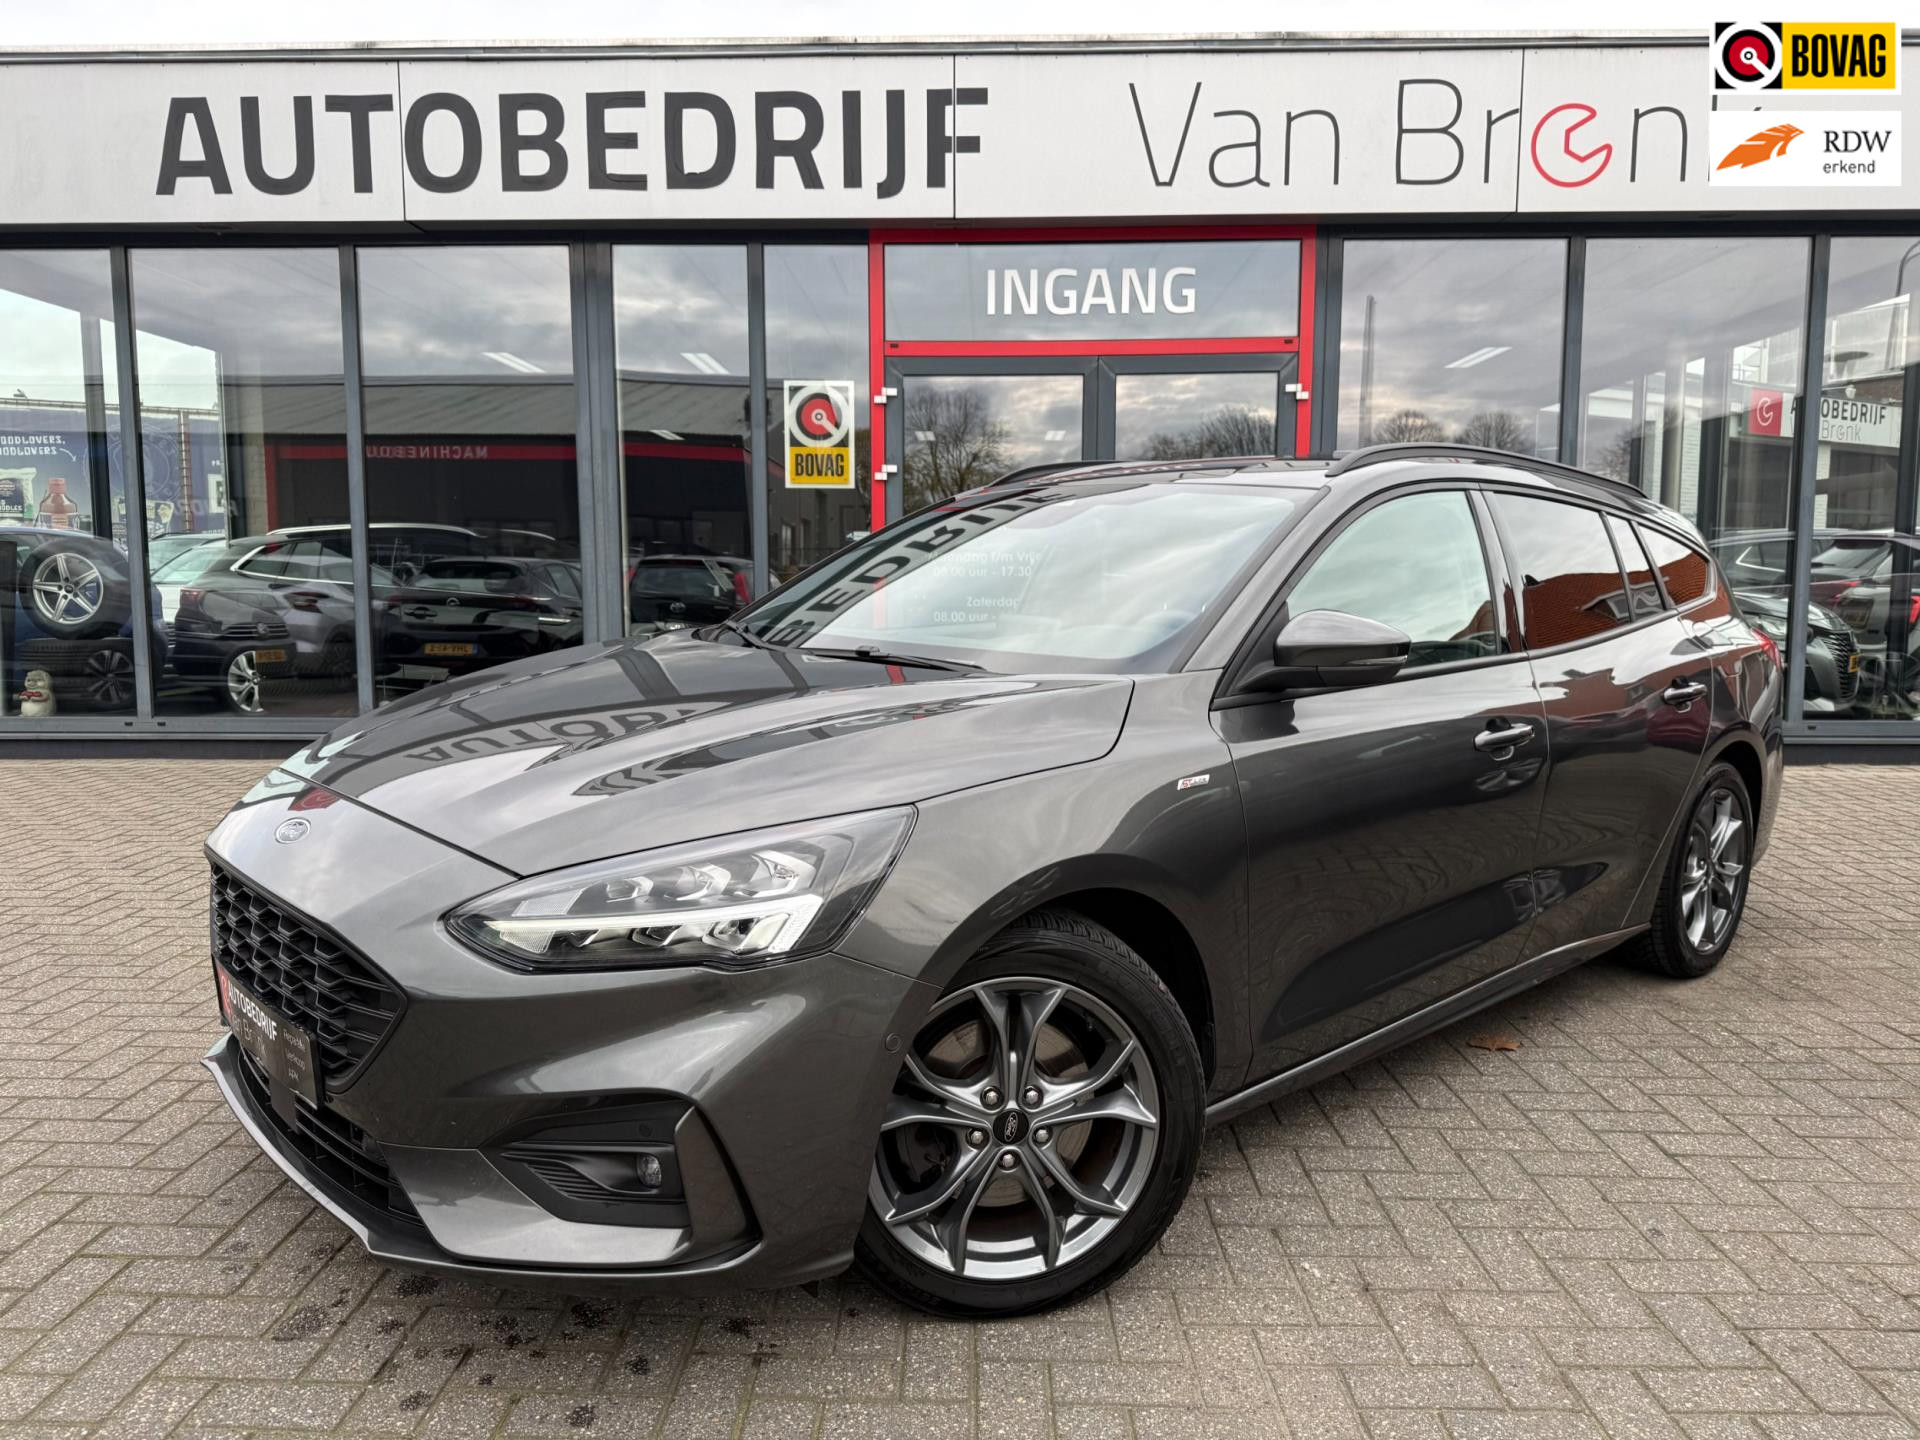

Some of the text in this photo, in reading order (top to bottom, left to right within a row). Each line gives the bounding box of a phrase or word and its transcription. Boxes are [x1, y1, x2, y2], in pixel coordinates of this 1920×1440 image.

[155, 87, 989, 199] AUTOBEDRIJF
[1128, 79, 1762, 188] Van Bren
[986, 266, 1196, 316] INGANG
[0, 435, 66, 445] OODLOVERS,
[794, 453, 845, 477] BOVAG
[1001, 566, 1032, 577] 17.30
